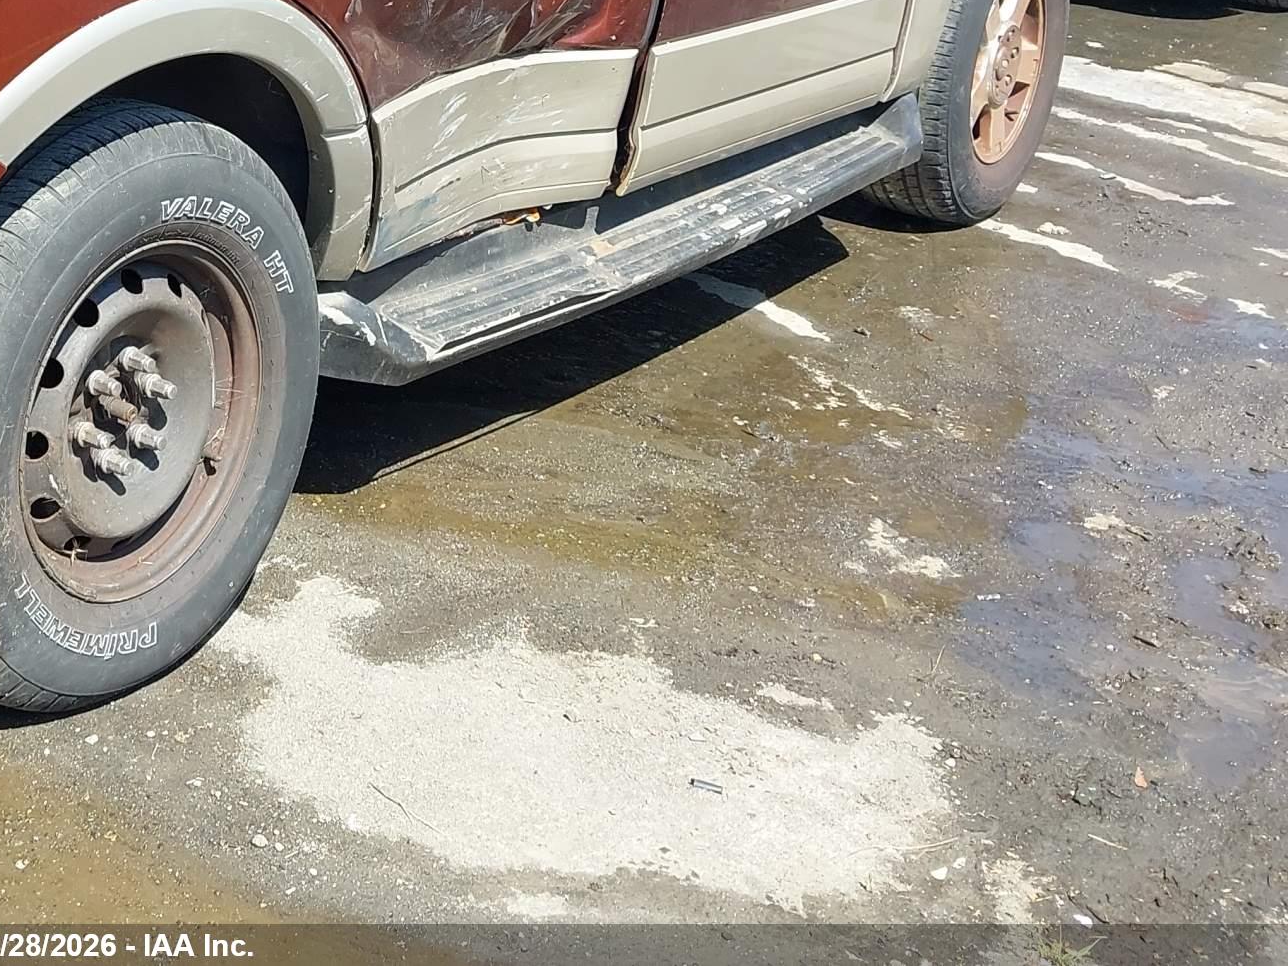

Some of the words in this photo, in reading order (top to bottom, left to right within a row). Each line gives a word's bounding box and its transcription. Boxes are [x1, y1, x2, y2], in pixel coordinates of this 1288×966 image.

[160, 195, 265, 250] VALERA
[263, 249, 295, 294] HT
[13, 571, 158, 661] PRIMEWELL
